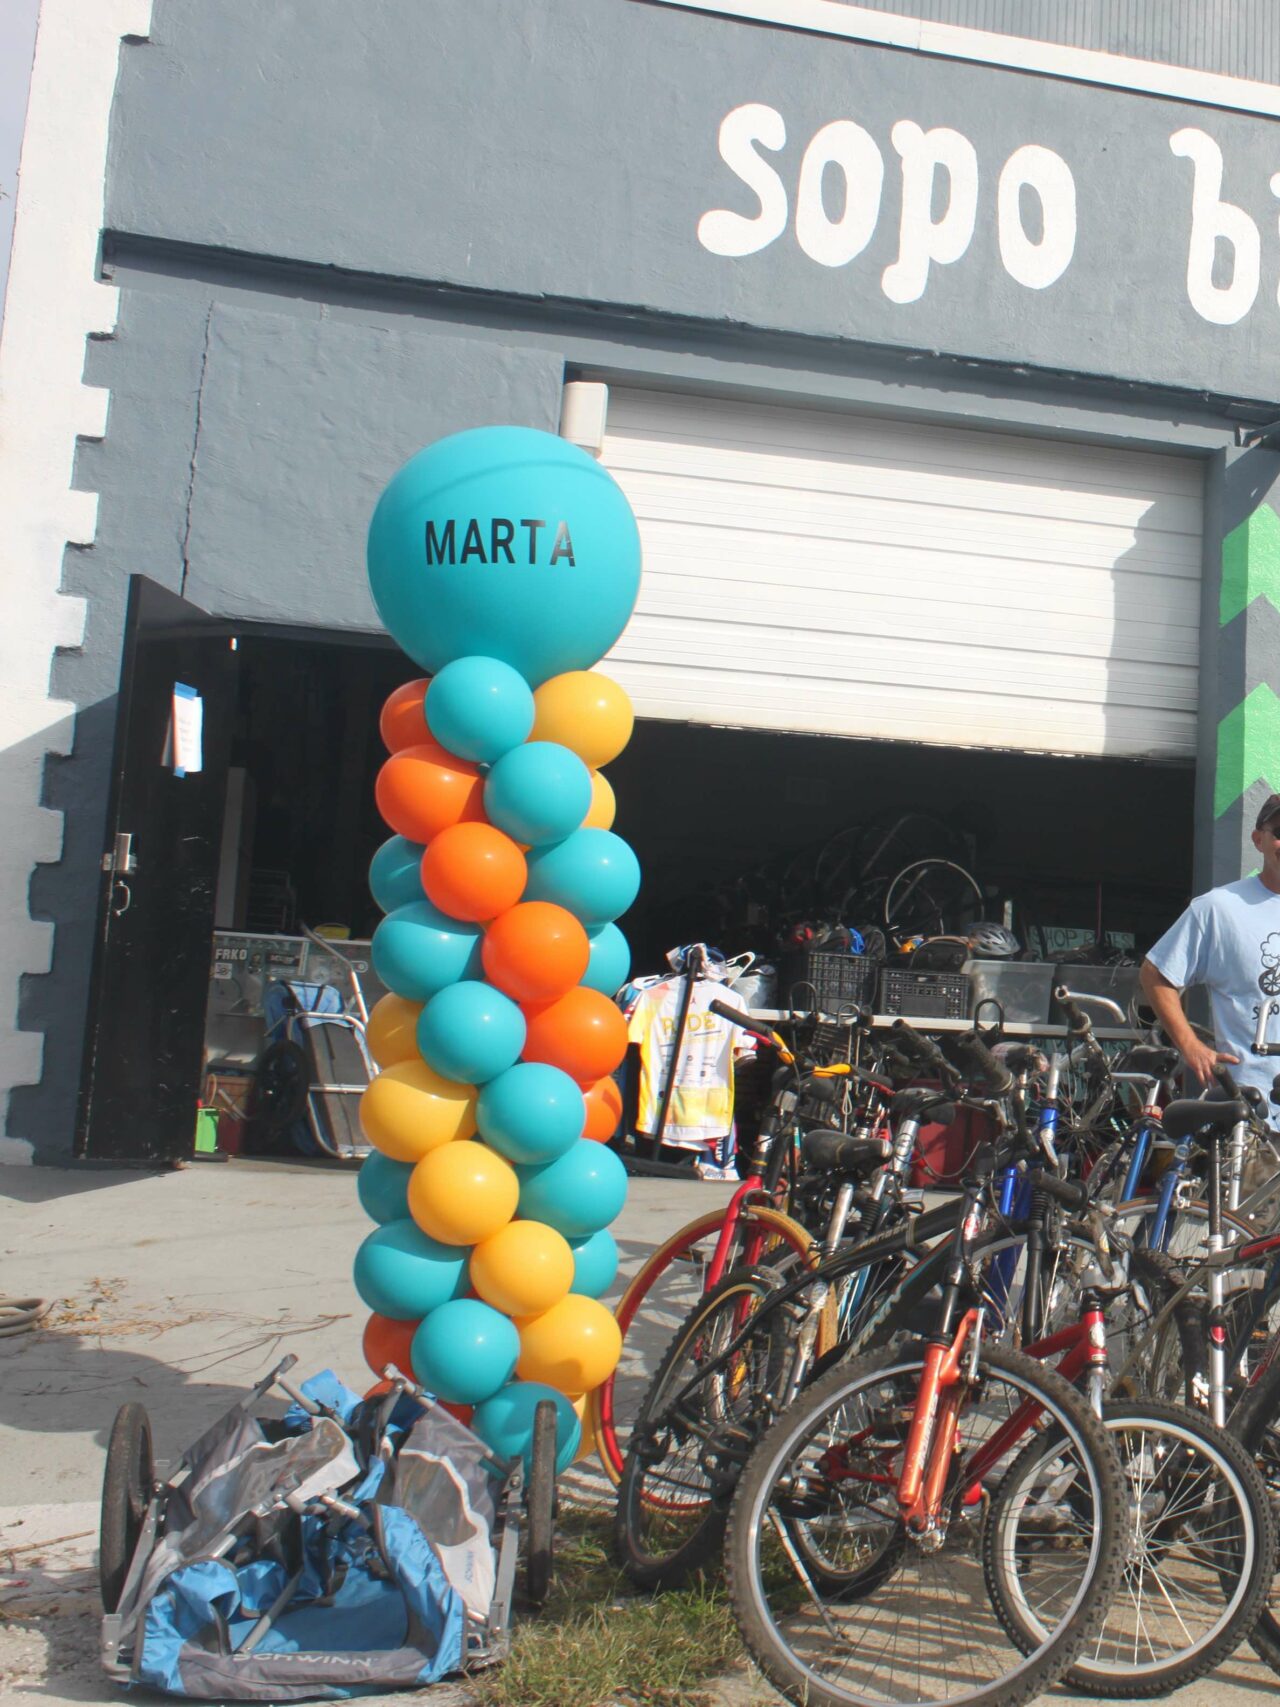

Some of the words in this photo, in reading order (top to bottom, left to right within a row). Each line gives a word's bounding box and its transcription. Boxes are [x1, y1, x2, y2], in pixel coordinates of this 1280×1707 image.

[697, 103, 1077, 304] sopo
[424, 518, 576, 567] MARTA
[661, 1011, 716, 1035] RDE
[232, 1652, 373, 1668] SCHWINN
